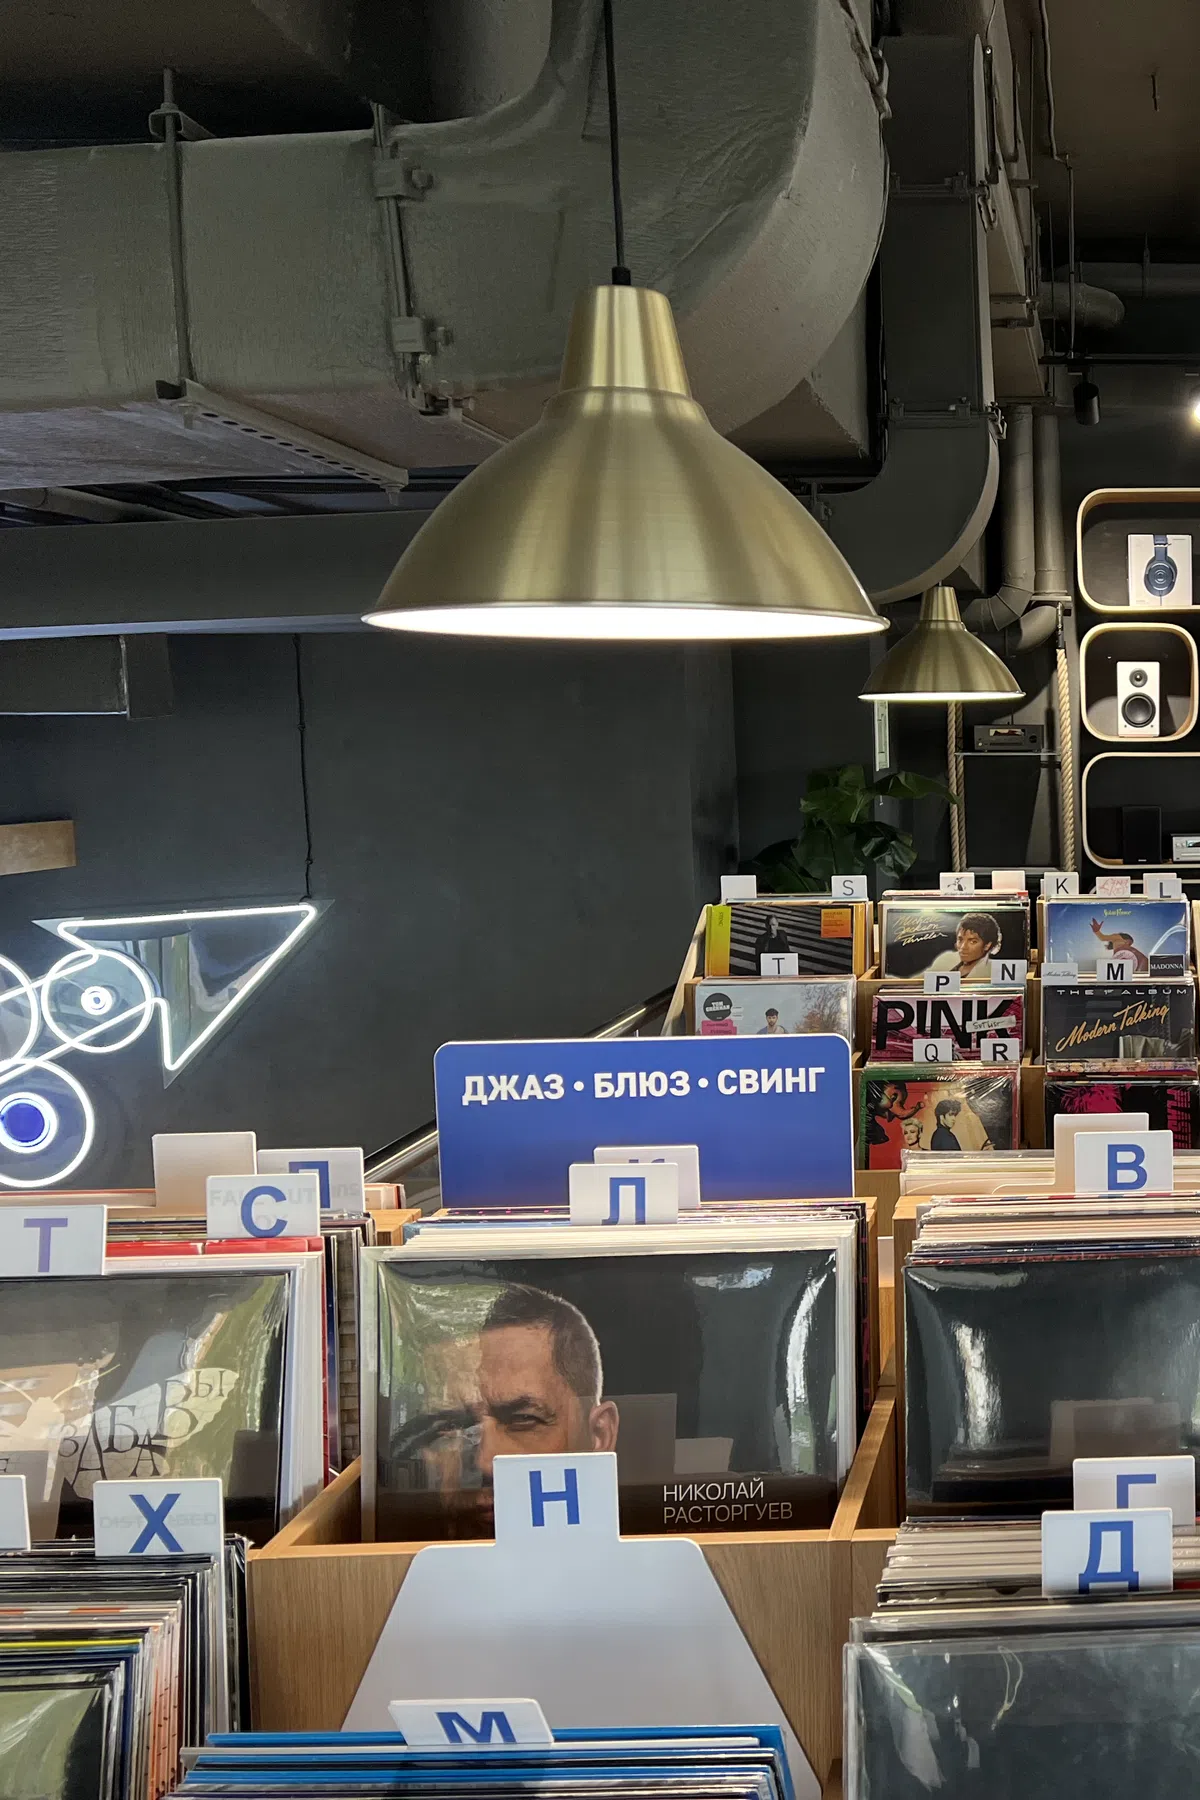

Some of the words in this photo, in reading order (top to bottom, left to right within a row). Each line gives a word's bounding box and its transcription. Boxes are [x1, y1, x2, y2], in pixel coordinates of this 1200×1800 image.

[842, 879, 855, 897] S
[1056, 878, 1069, 894] K
[1159, 882, 1172, 898] L
[902, 931, 948, 947] Thriller
[772, 957, 785, 974] T
[1001, 963, 1016, 981] N
[1106, 963, 1124, 981] M
[936, 975, 950, 992] P
[1055, 1019, 1116, 1052] Modern
[1113, 1000, 1169, 1031] Talking
[925, 1043, 940, 1062] Q
[992, 1043, 1009, 1061] R
[462, 1074, 565, 1106] ДЖАЗ
[594, 1070, 691, 1099] БЛЮЗ
[717, 1067, 826, 1095] СВИНГ
[1107, 1143, 1149, 1191] В
[240, 1185, 289, 1238] С
[23, 1217, 68, 1273] Т
[528, 1467, 580, 1527] Н
[662, 1477, 765, 1502] НИКОЛАЙ
[1116, 1473, 1157, 1509] Г
[662, 1501, 794, 1525] РАСТОРГУЕВ
[1078, 1520, 1140, 1594] Д
[434, 1711, 518, 1744] М
